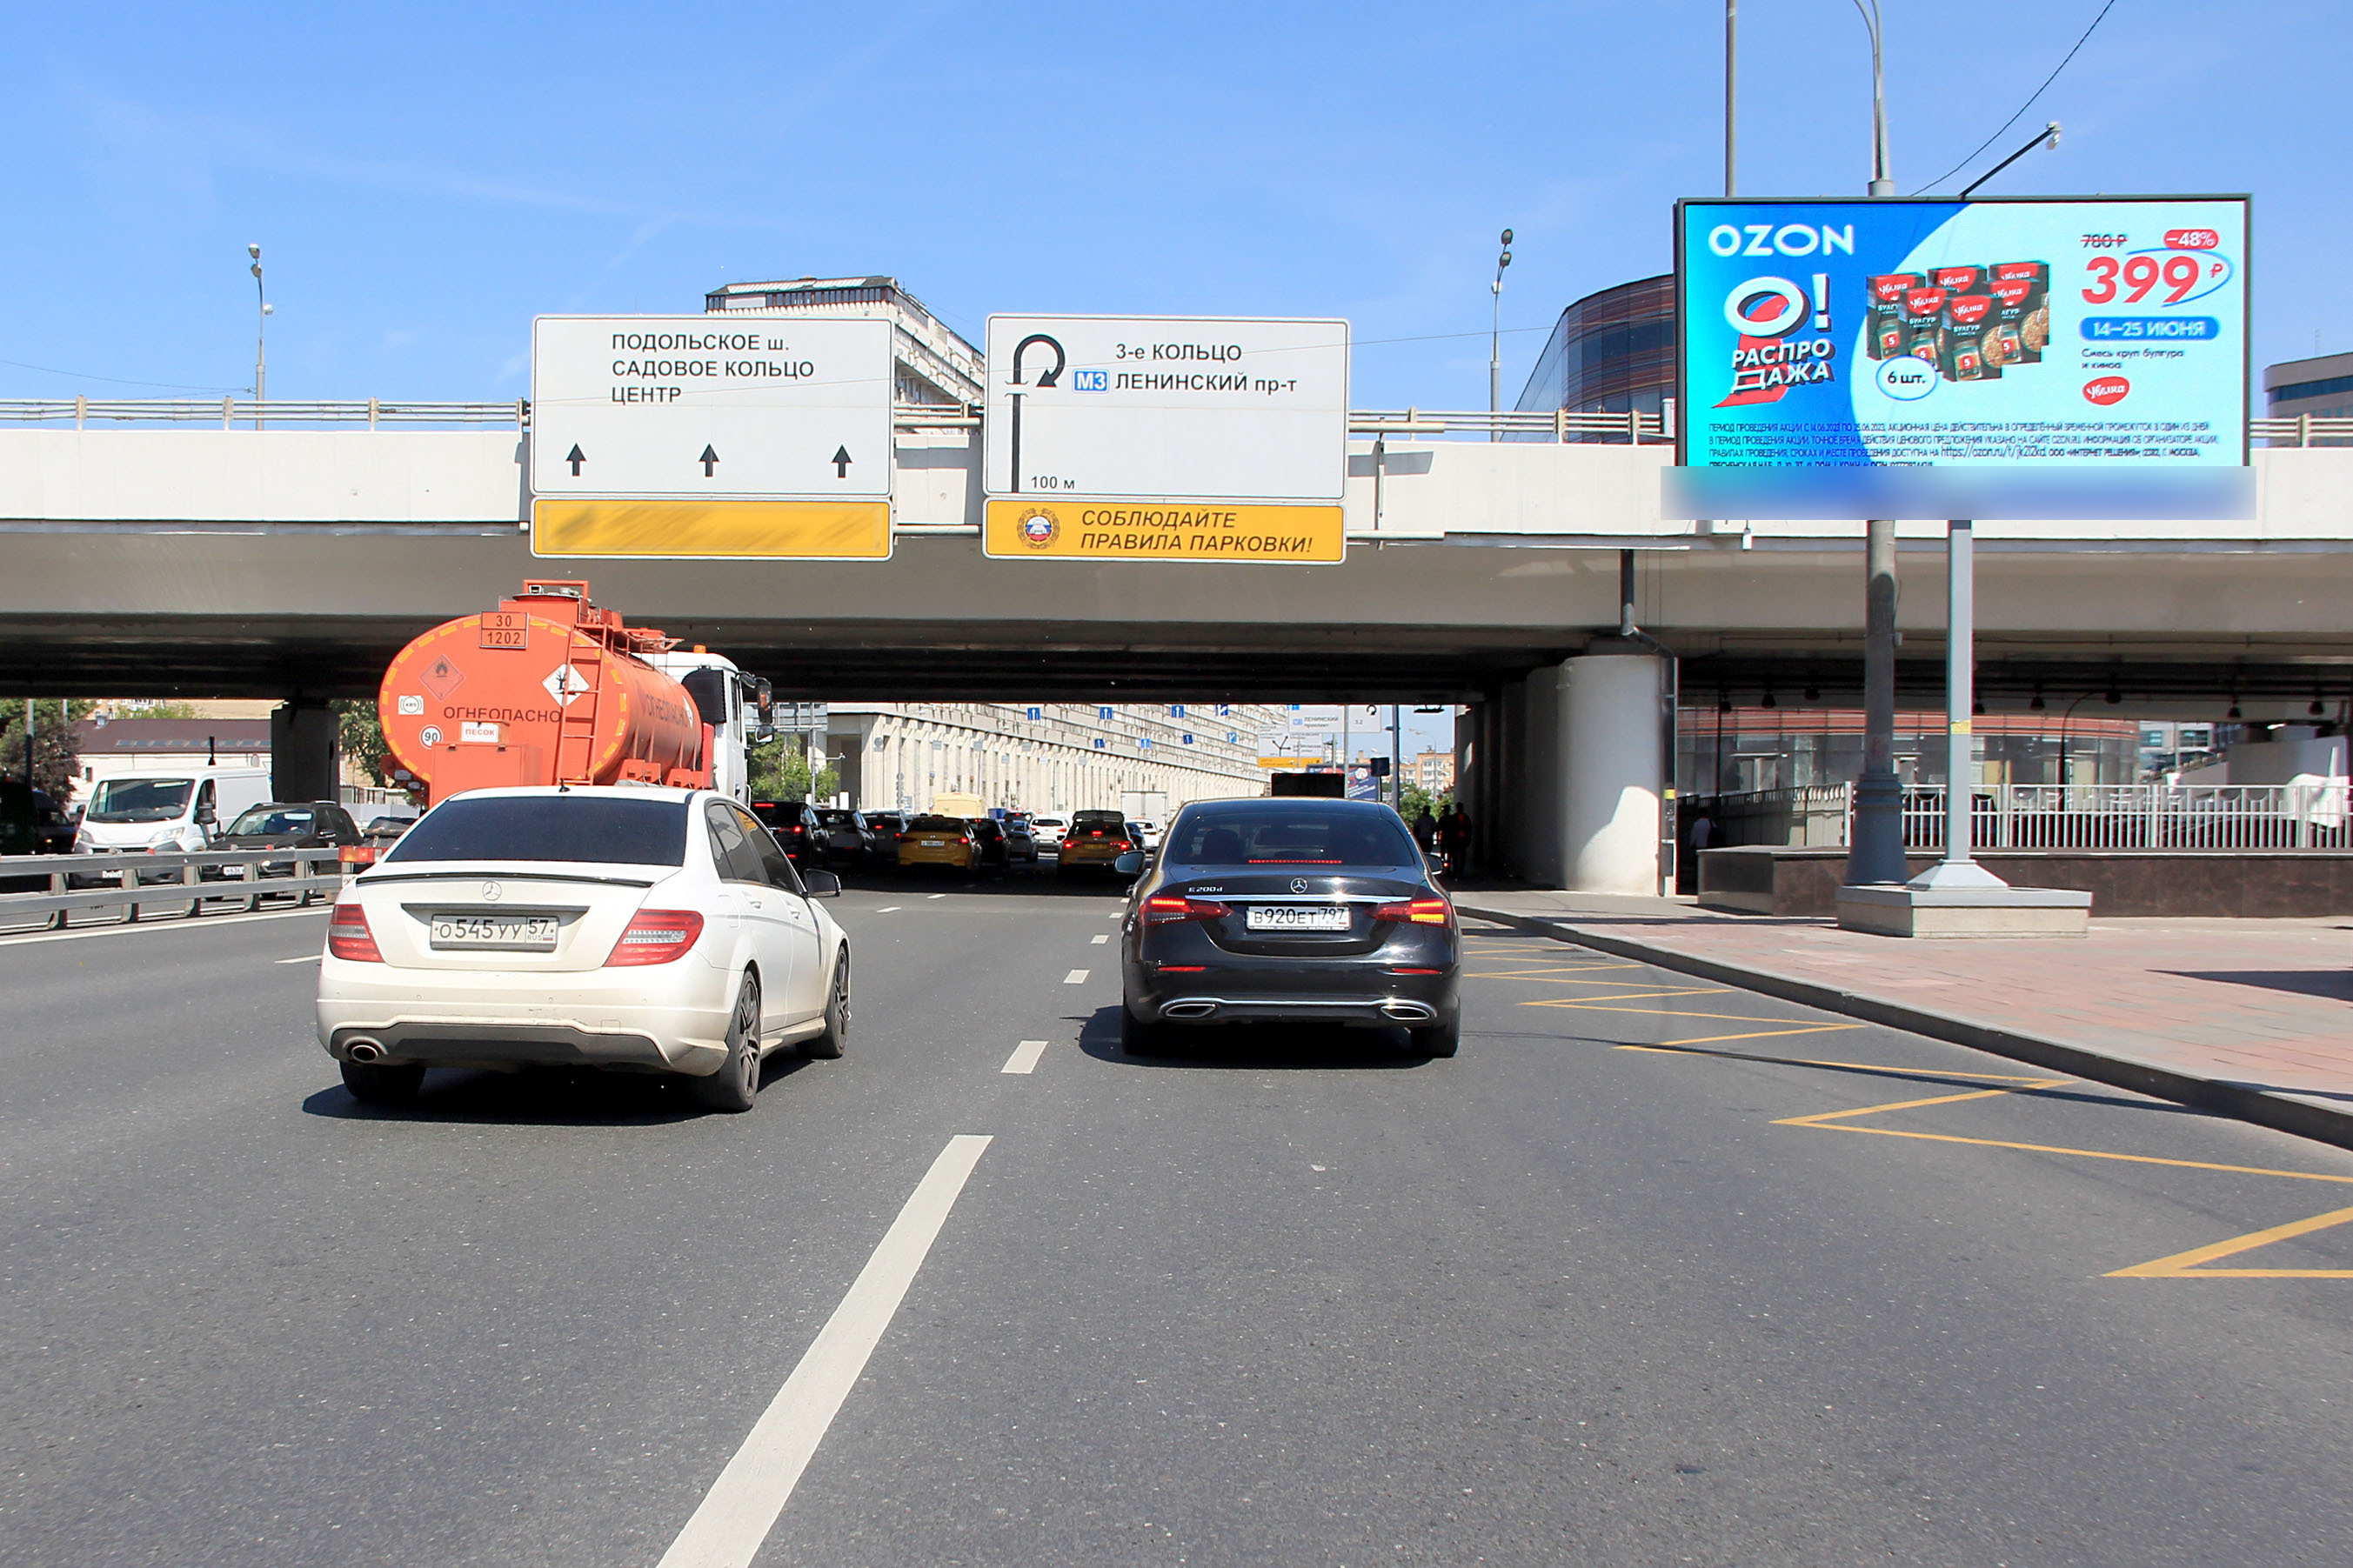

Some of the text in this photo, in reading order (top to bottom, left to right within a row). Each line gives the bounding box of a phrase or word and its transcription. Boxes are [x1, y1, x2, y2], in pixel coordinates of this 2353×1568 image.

[1708, 224, 1854, 257] OZON
[2082, 234, 2112, 248] 780
[2082, 256, 2199, 304] 399
[2146, 321, 2206, 337] ИЮНЯ
[612, 334, 790, 352] ПОДОЛЬСКОЕ ш.
[1116, 344, 1241, 364] 3-е КОЛЬЦО
[1733, 338, 1835, 368] РАСПРО
[2082, 349, 2113, 357] Смесь
[2142, 349, 2184, 358] булгура
[612, 361, 814, 379] САДОВОЕ КОЛЬЦО
[1731, 361, 1833, 393] ДАЖА
[1888, 371, 1925, 384] 6 шт.
[1116, 371, 1247, 391] ЛЕНИНСКИЙ
[1255, 377, 1297, 395] пр-т
[612, 387, 681, 405] ЦЕНТР
[1031, 476, 1075, 490] 100 м
[1081, 508, 1236, 529] СОБЛЮДАЙТЕ
[1080, 533, 1312, 553] ПРАВИЛА ПАРКОВКИ!
[496, 615, 511, 627] 30
[486, 631, 521, 644] 1202
[444, 706, 561, 723] ОГНЕОПАСНО
[424, 731, 438, 742] 90
[1320, 908, 1345, 920] 797
[528, 919, 549, 935] 57
